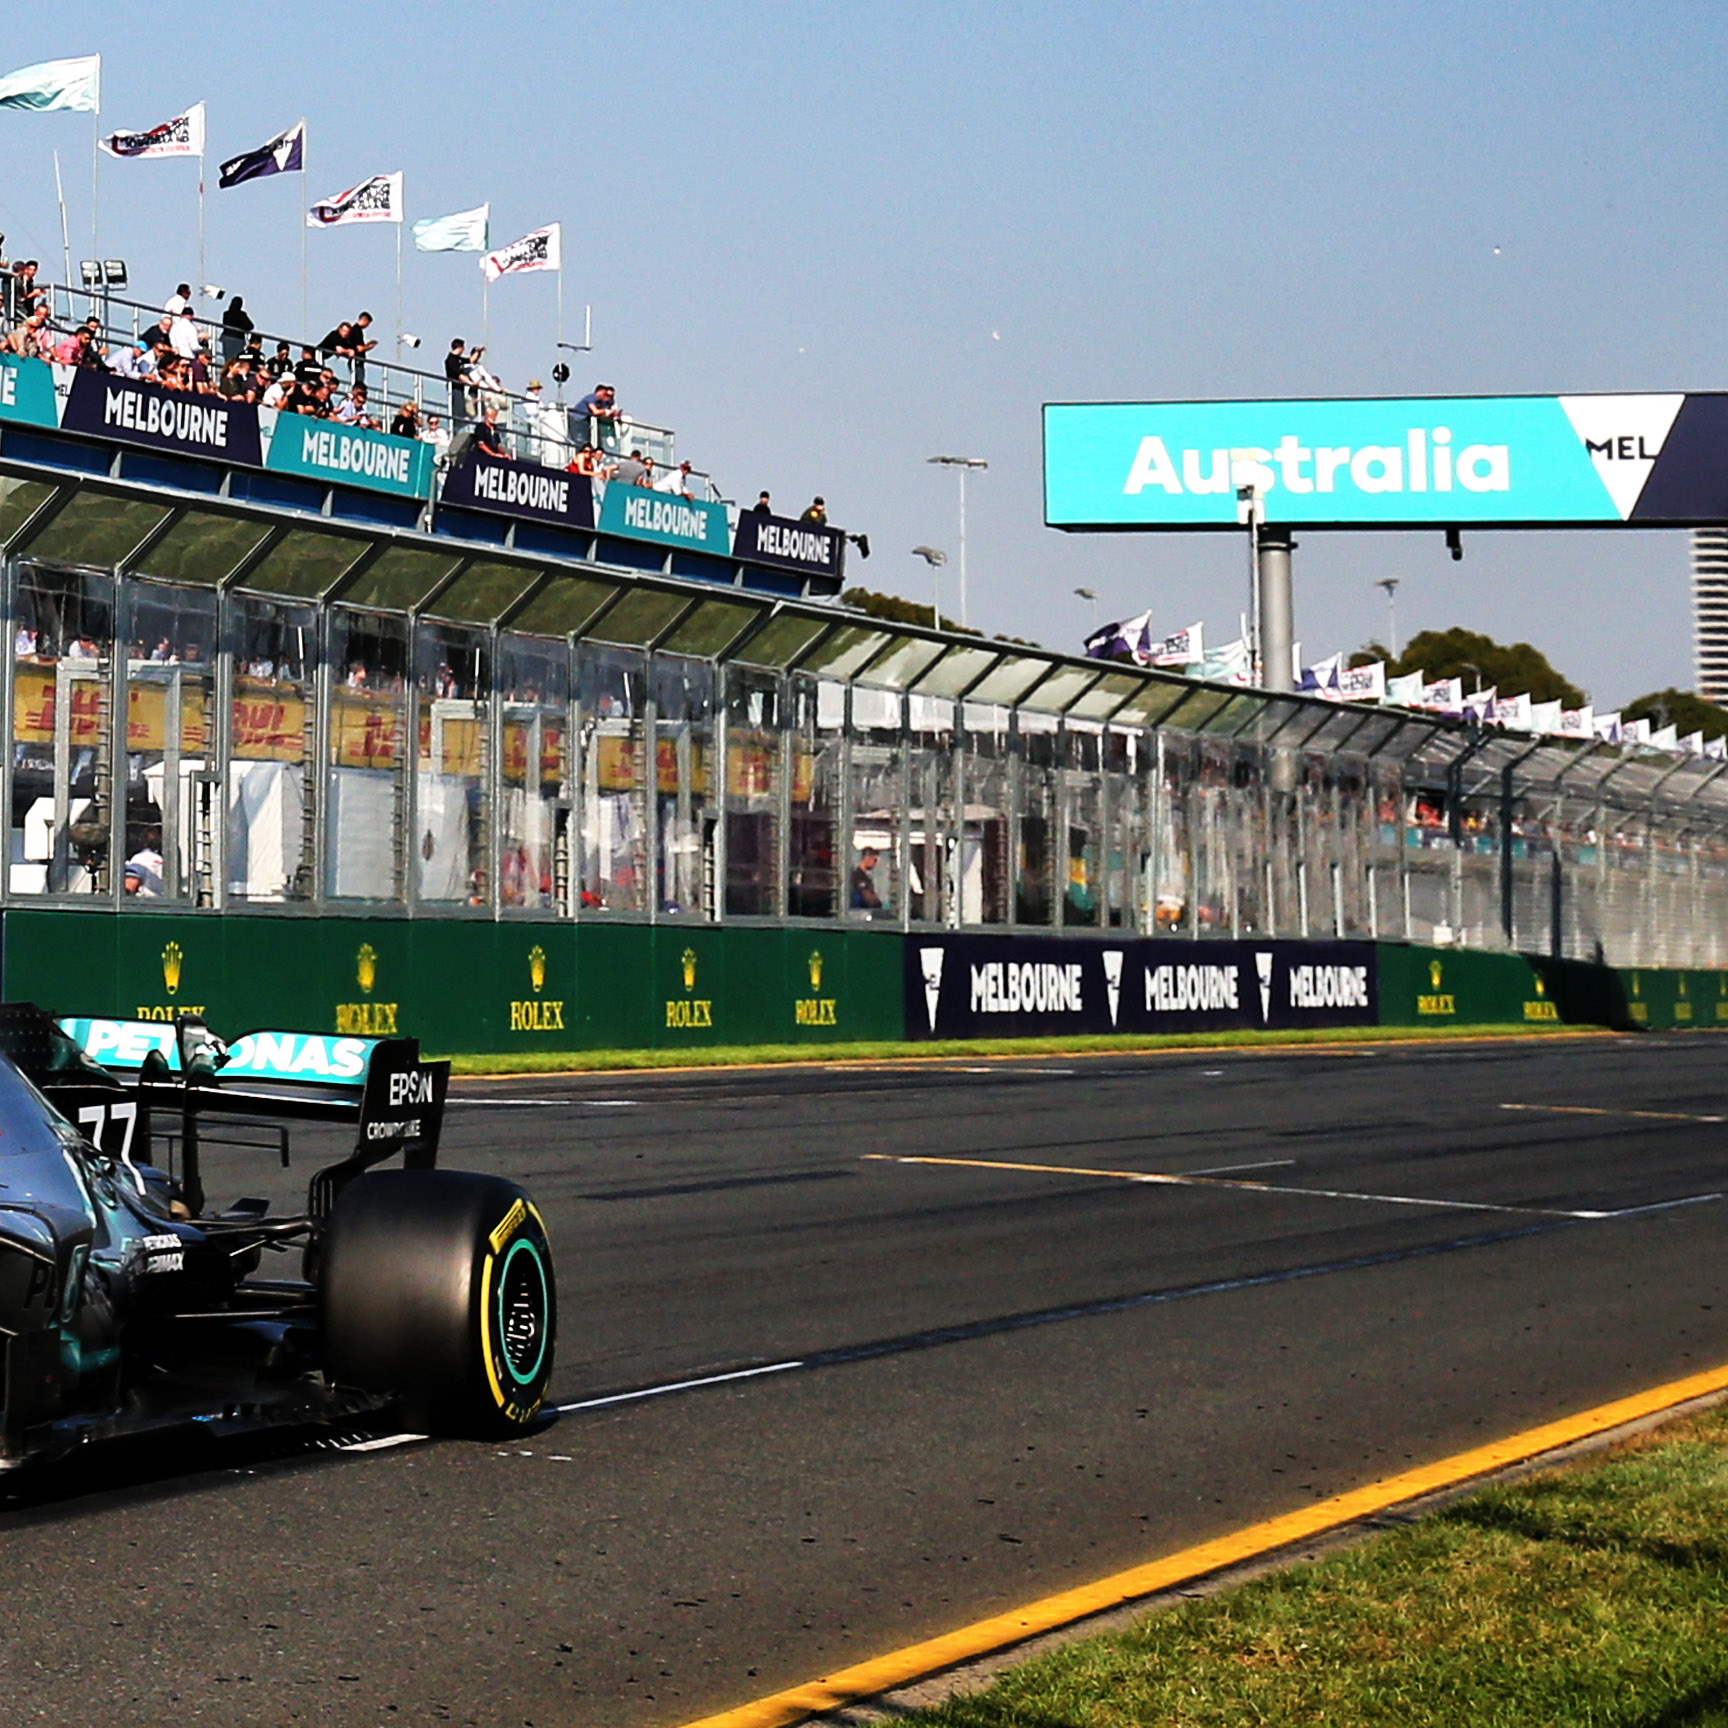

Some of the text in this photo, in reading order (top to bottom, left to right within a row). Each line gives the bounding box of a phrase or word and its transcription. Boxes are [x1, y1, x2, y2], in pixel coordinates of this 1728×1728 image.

[104, 386, 228, 448] MELBOURNE
[302, 428, 411, 483] MELBOURNE
[1123, 426, 1658, 495] Australia MEL
[474, 463, 569, 513] MELBOURNE
[625, 496, 708, 541] MELBOURNE
[757, 523, 831, 565] MELBOURNE
[970, 962, 1083, 1014] MELBOURNE
[1144, 962, 1239, 1011] MELBOURNE
[1289, 965, 1368, 1008] MELBOURNE
[335, 1003, 398, 1035] ROLEX
[510, 1000, 566, 1032] ROLEX
[666, 999, 712, 1029] ROLEX
[795, 997, 837, 1027] ROLEX
[78, 1101, 147, 1195] 77
